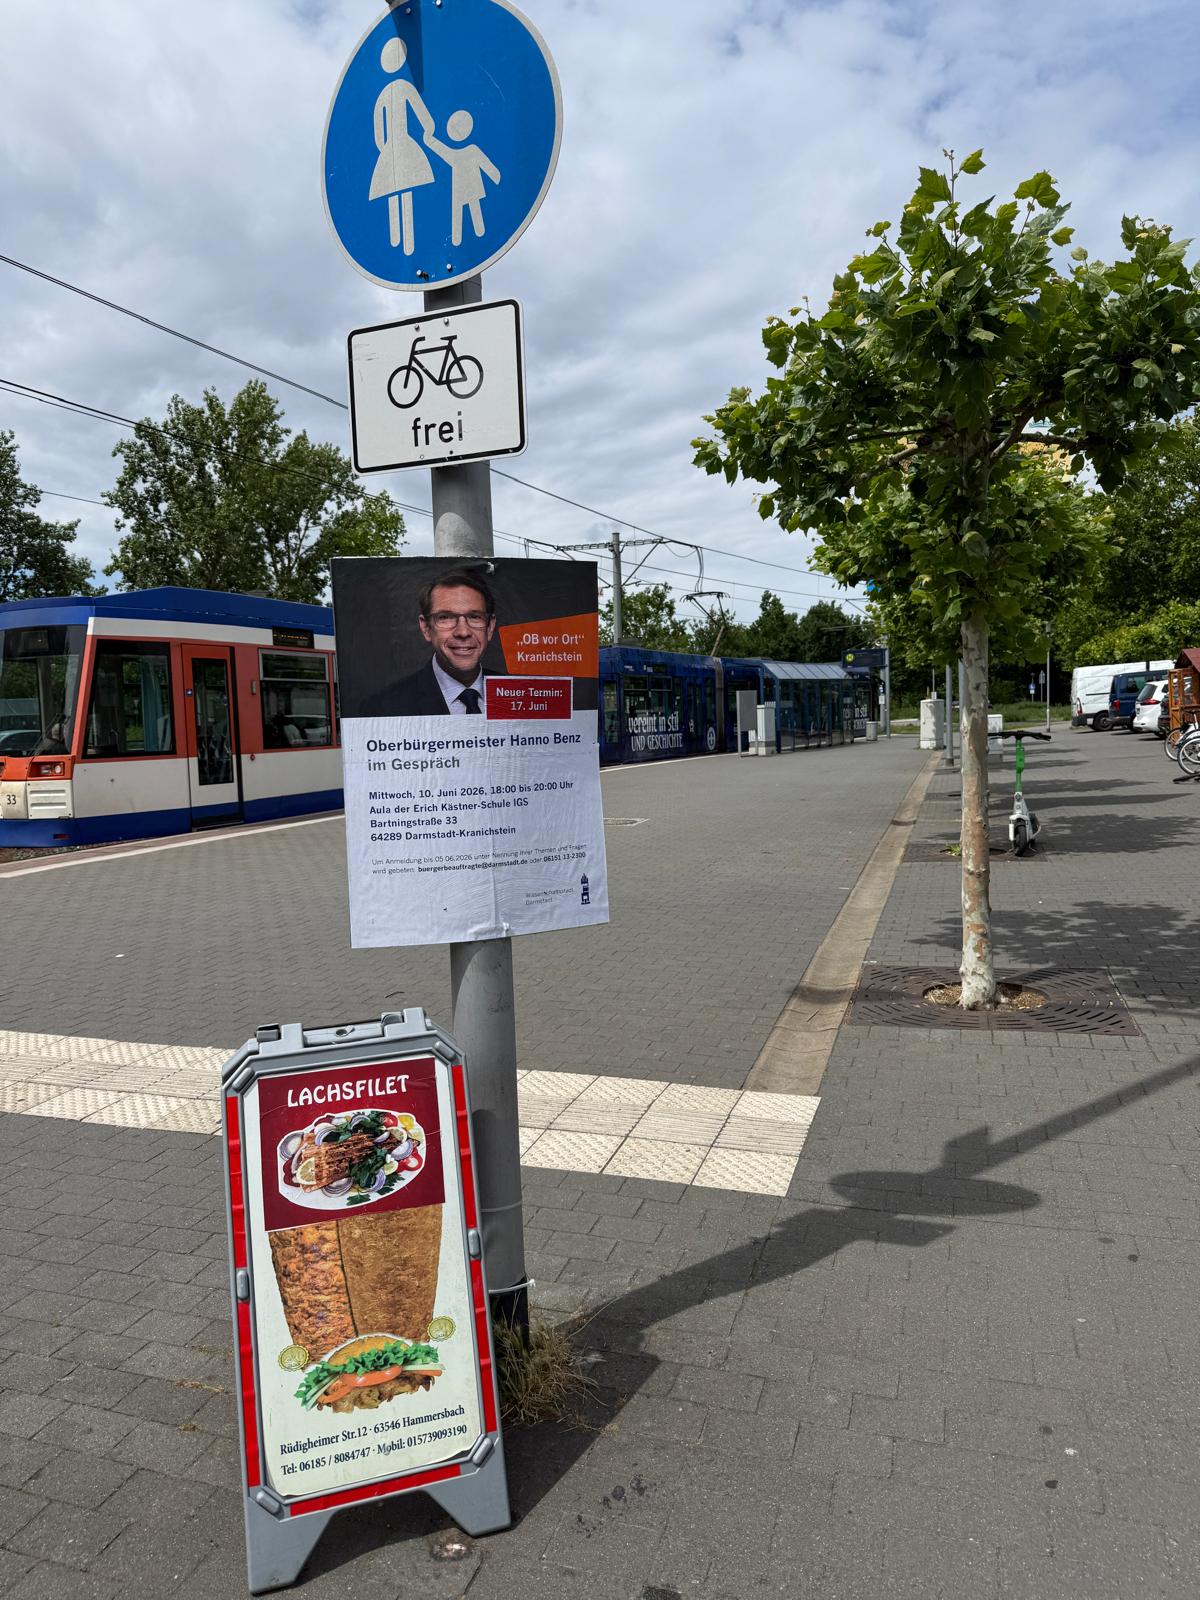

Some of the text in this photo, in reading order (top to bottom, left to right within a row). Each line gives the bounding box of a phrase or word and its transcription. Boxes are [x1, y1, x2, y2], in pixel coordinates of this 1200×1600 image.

[412, 411, 463, 447] frei
[516, 633, 540, 646] „OB
[543, 635, 558, 645] vor
[517, 651, 582, 662] Kranichstein
[496, 687, 563, 697] Neuer Termin:
[511, 701, 548, 711] 17. Juni
[628, 711, 680, 734] vereint in stil
[366, 732, 581, 753] Oberbürgermeister Hanno Benz
[631, 733, 684, 752] UND GESCHICHTE
[368, 756, 460, 772] im Gespräch
[369, 790, 415, 800] Mittwoch,
[419, 789, 434, 798] 10.
[437, 788, 457, 797] Juni
[490, 784, 517, 795] 18:00
[519, 783, 532, 793] bis
[533, 782, 557, 791] 20:00
[559, 780, 574, 789] Uhr
[6, 794, 17, 805] 33
[369, 797, 529, 814] Aula der Erich Kästner-Schule IGS
[370, 816, 458, 829] Bartningstraße 33
[370, 826, 516, 842] 64289 Darmstadt-Kranichstein
[385, 857, 422, 865] Anmeldung
[543, 854, 561, 863] 06151
[287, 1074, 410, 1108] LACHSFILET
[280, 1405, 465, 1456] Rüdigheimer Str.12 63546 Hammersbach
[280, 1463, 298, 1476] Tel:
[299, 1456, 326, 1473] 06185
[334, 1446, 371, 1465] 8084747
[377, 1439, 406, 1456] Mobil:
[406, 1424, 467, 1448] 015739093190
